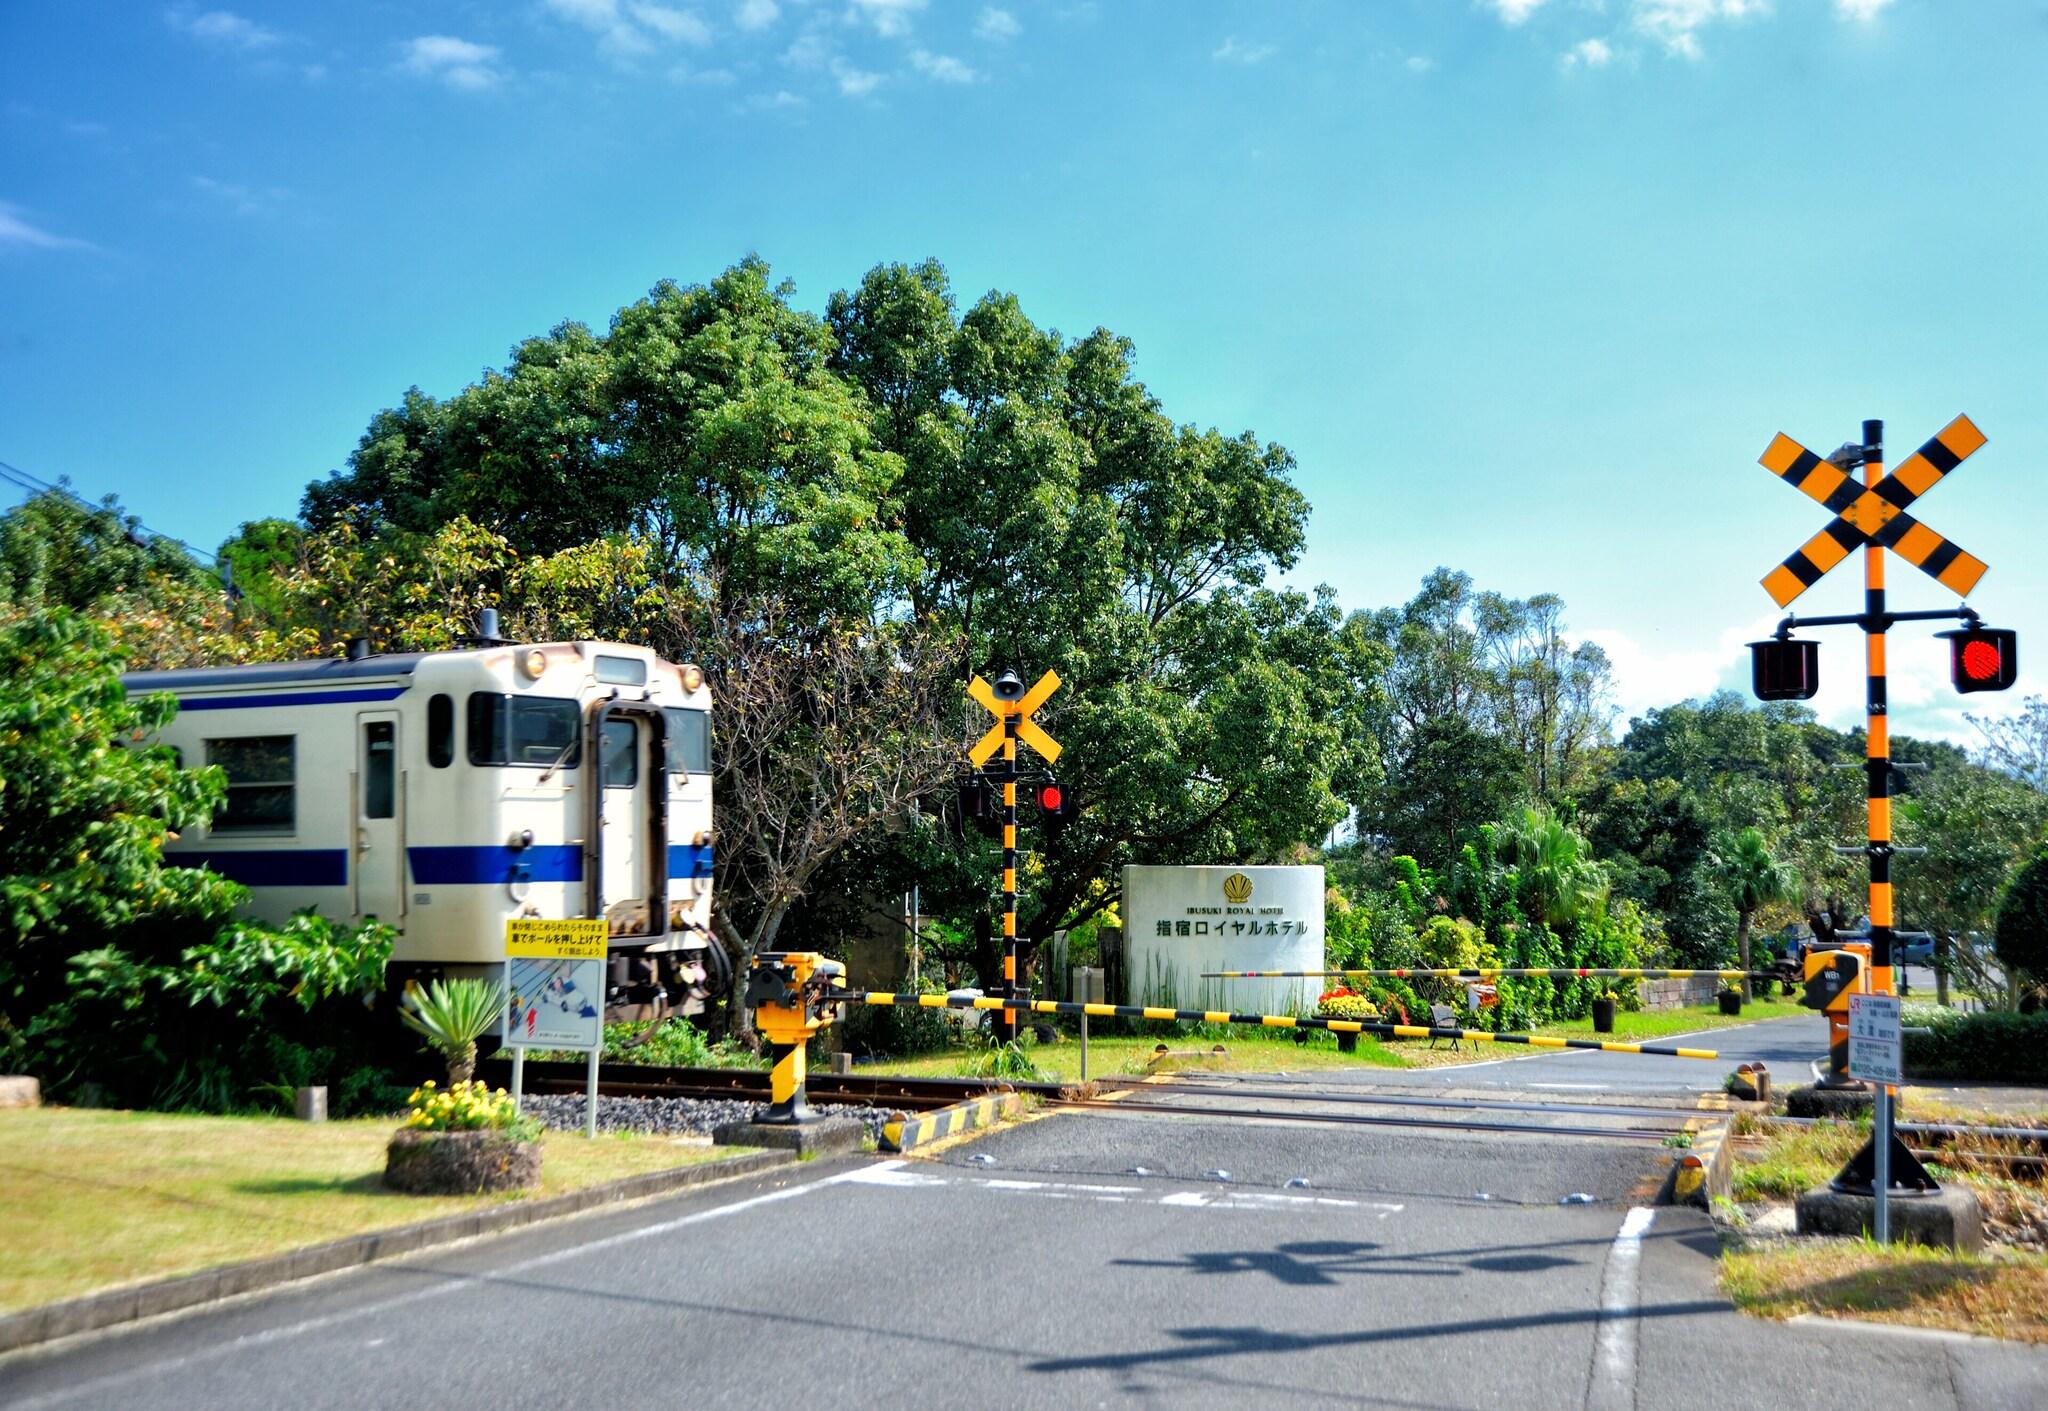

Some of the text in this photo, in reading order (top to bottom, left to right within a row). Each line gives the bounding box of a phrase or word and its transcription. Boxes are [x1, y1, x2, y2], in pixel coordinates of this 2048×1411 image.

[1186, 907, 1222, 915] IBUSUKI
[1156, 919, 1308, 937] 指宿ロイヤルホテル
